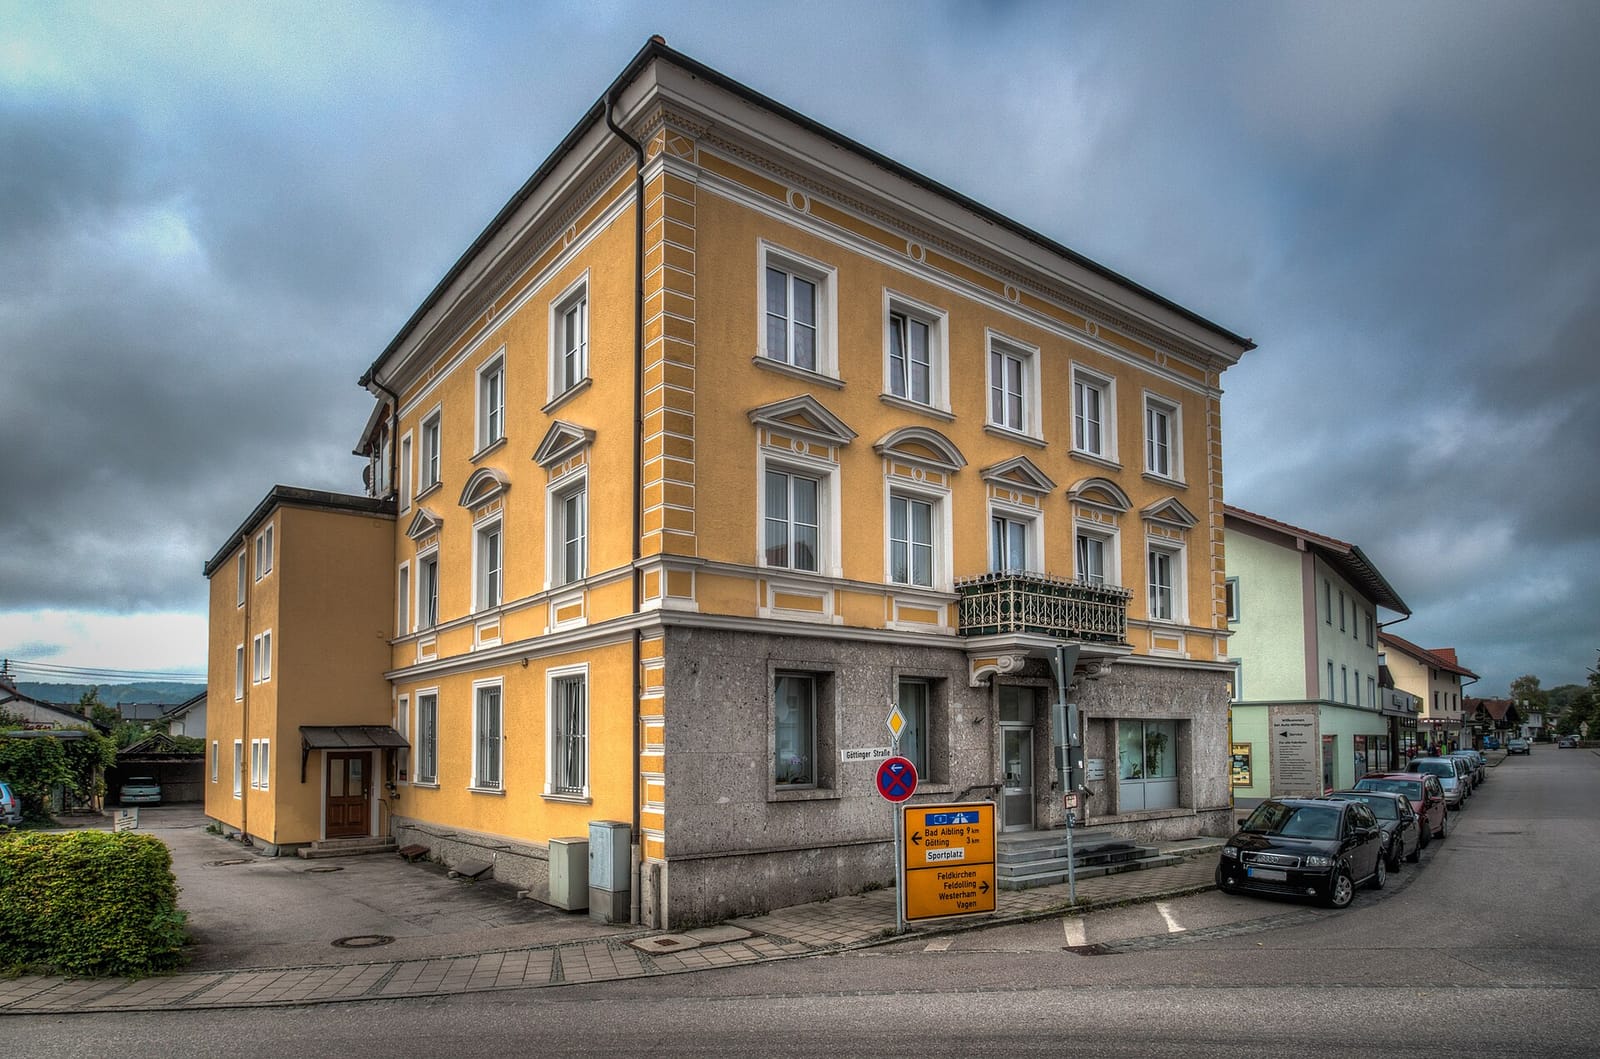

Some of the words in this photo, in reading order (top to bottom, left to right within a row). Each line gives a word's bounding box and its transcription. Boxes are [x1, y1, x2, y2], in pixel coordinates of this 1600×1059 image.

[846, 750, 871, 760] Göttinger
[872, 748, 890, 758] Straße
[925, 828, 938, 837] Bad
[940, 827, 964, 836] Aibling
[966, 826, 971, 834] 9
[925, 838, 950, 847] Götting
[966, 836, 971, 844] 3
[927, 850, 963, 861] Sportplatz
[937, 870, 977, 880] Feldkirchen
[943, 880, 977, 890] Feldolling
[938, 890, 977, 900] Westerham
[956, 900, 977, 909] Vagen
